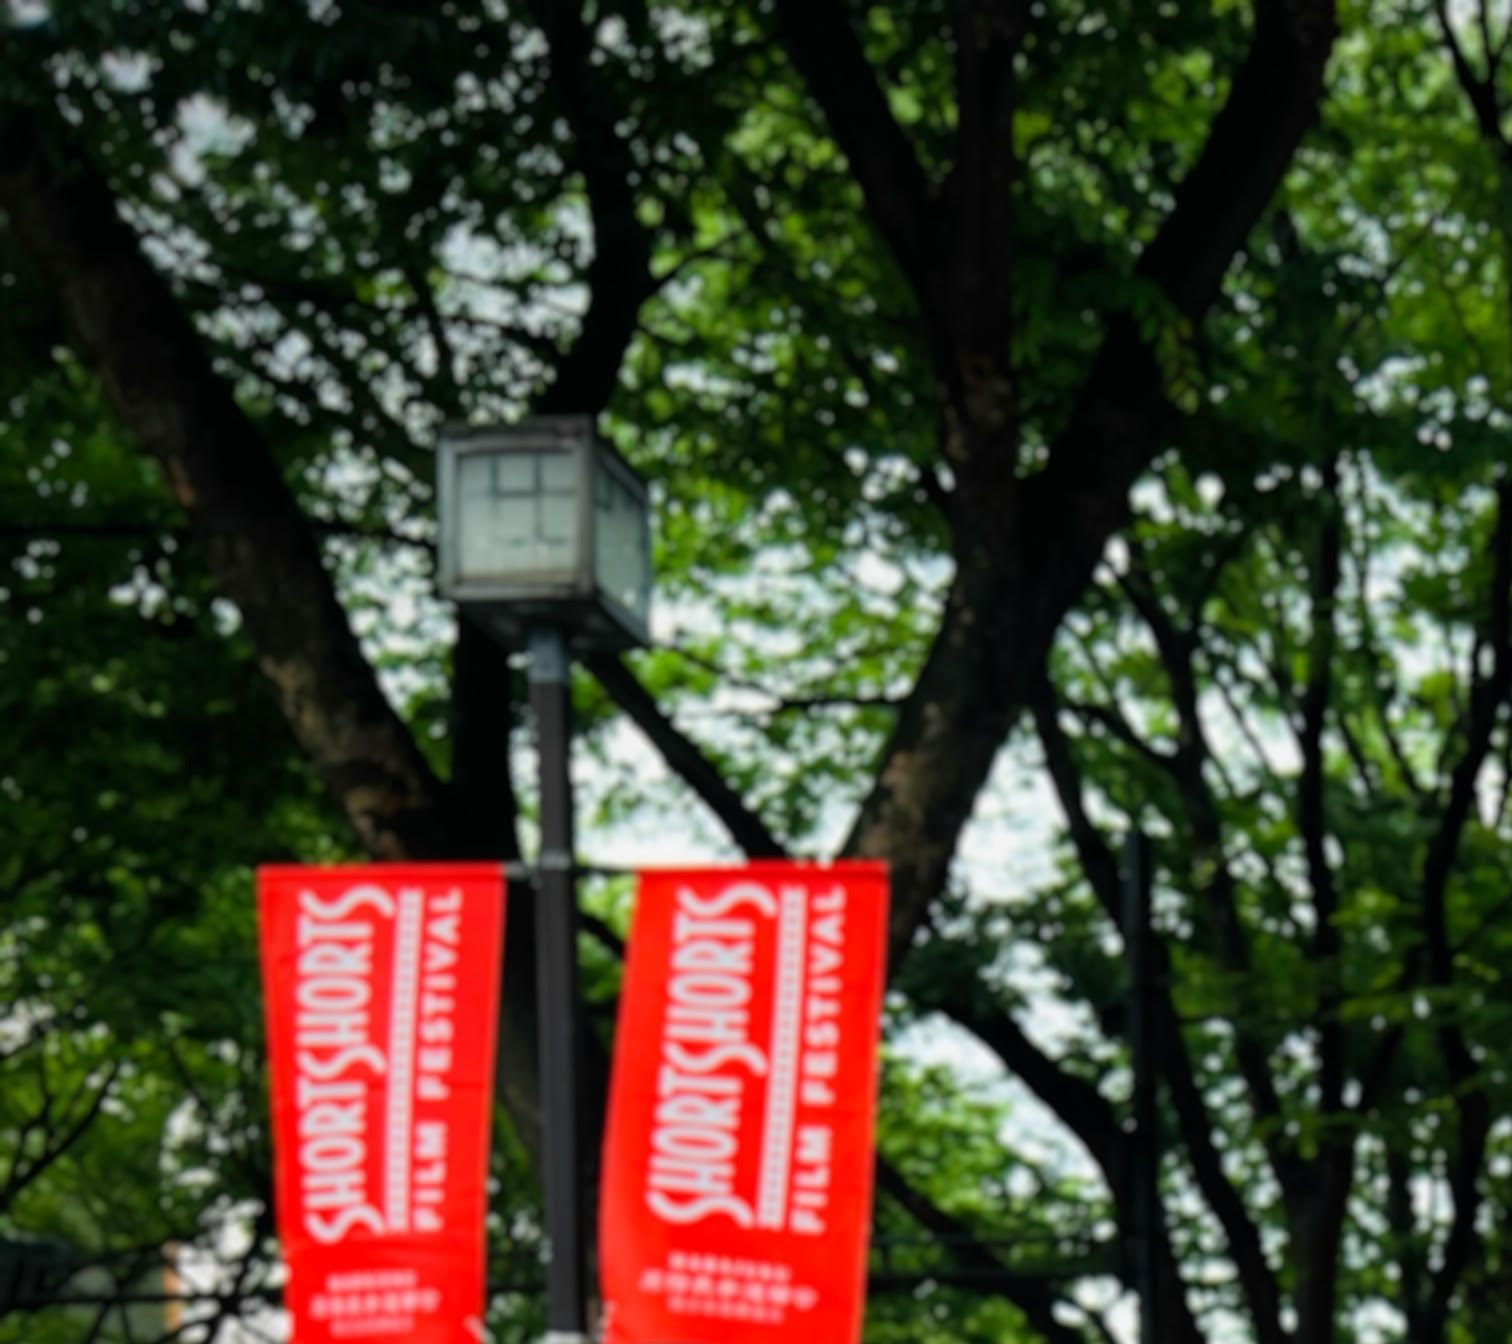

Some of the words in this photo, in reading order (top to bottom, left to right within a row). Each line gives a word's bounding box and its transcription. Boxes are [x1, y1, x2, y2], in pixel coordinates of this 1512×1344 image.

[417, 887, 463, 1101] FESTIVAL
[801, 886, 846, 1106] FESTIVAL
[412, 1121, 446, 1233] FILM
[790, 1125, 832, 1235] FILM
